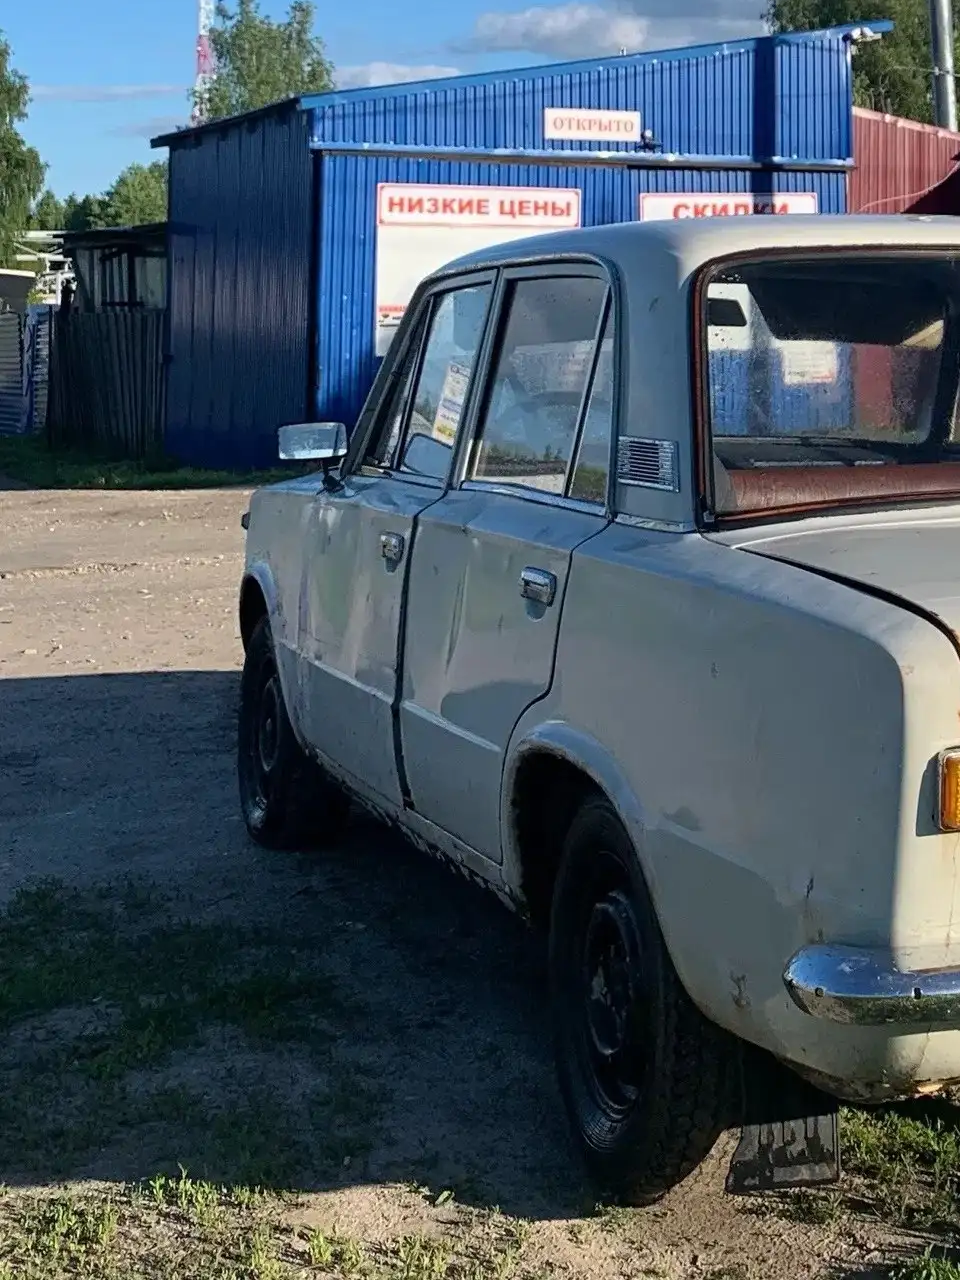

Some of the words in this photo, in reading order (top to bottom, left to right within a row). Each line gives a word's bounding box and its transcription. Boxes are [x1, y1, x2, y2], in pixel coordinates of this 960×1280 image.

[553, 116, 634, 133] ОТКРЫТО
[388, 196, 490, 215] НИЗКИЕ
[499, 200, 571, 219] ЦЕНЫ
